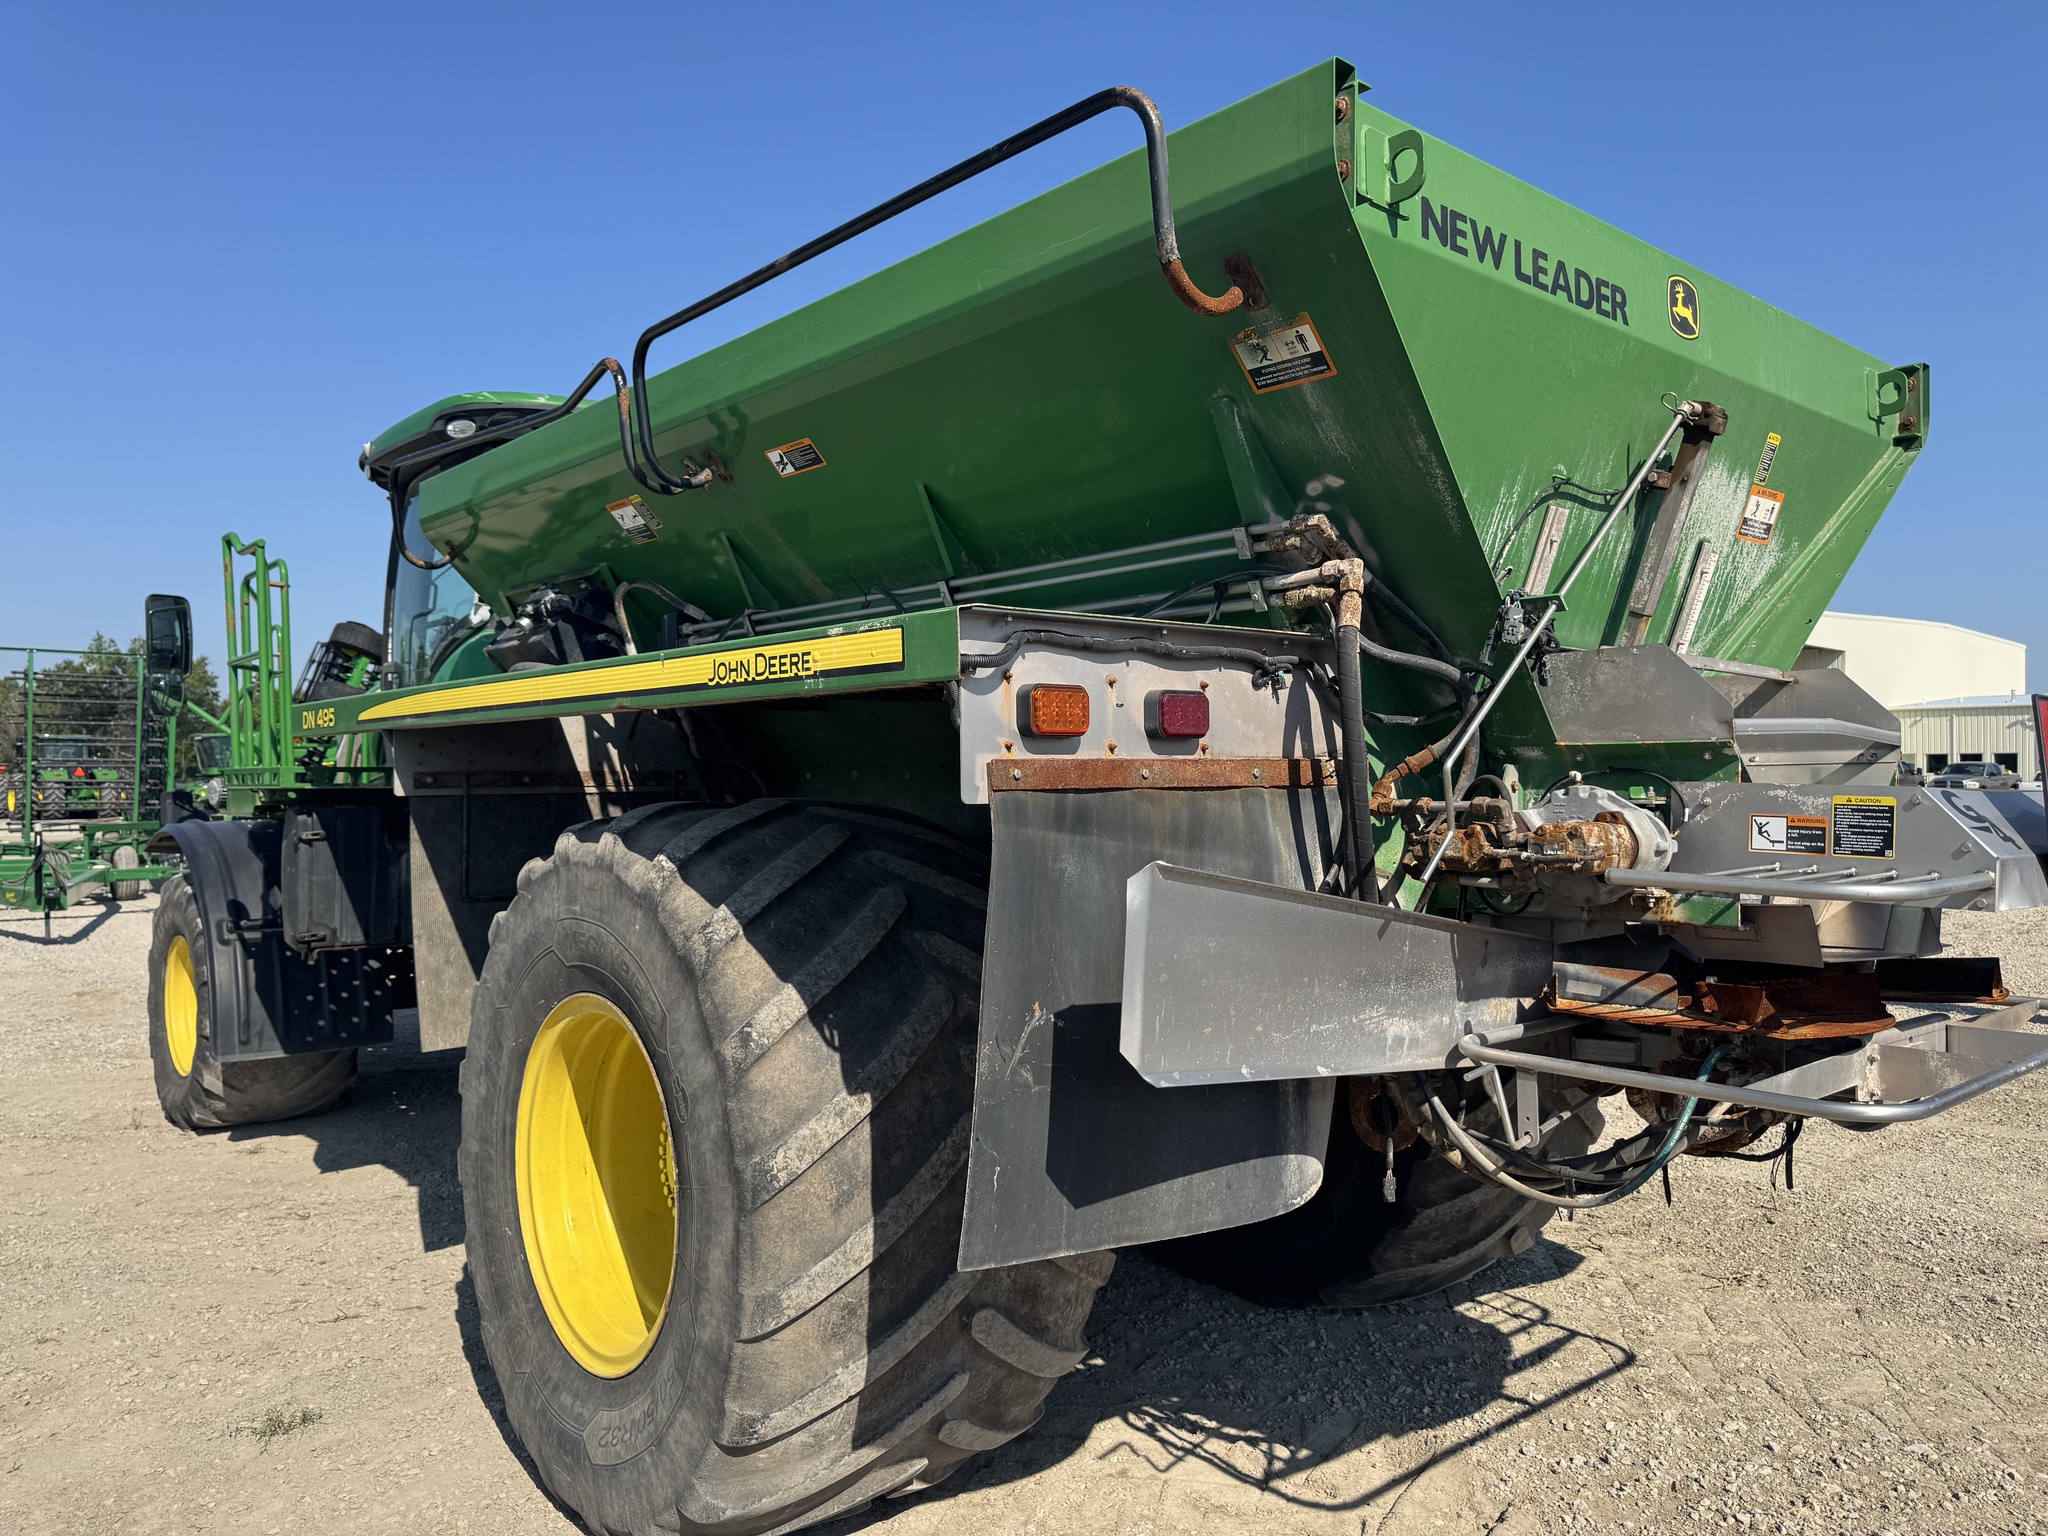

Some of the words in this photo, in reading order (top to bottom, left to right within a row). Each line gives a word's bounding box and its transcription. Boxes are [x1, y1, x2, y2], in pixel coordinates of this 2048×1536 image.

[1421, 195, 1507, 271] NEW
[1514, 238, 1630, 327] LEADER
[708, 659, 750, 682] JOHN
[755, 651, 812, 677] DEERE
[303, 710, 315, 729] DN
[317, 707, 335, 728] 495
